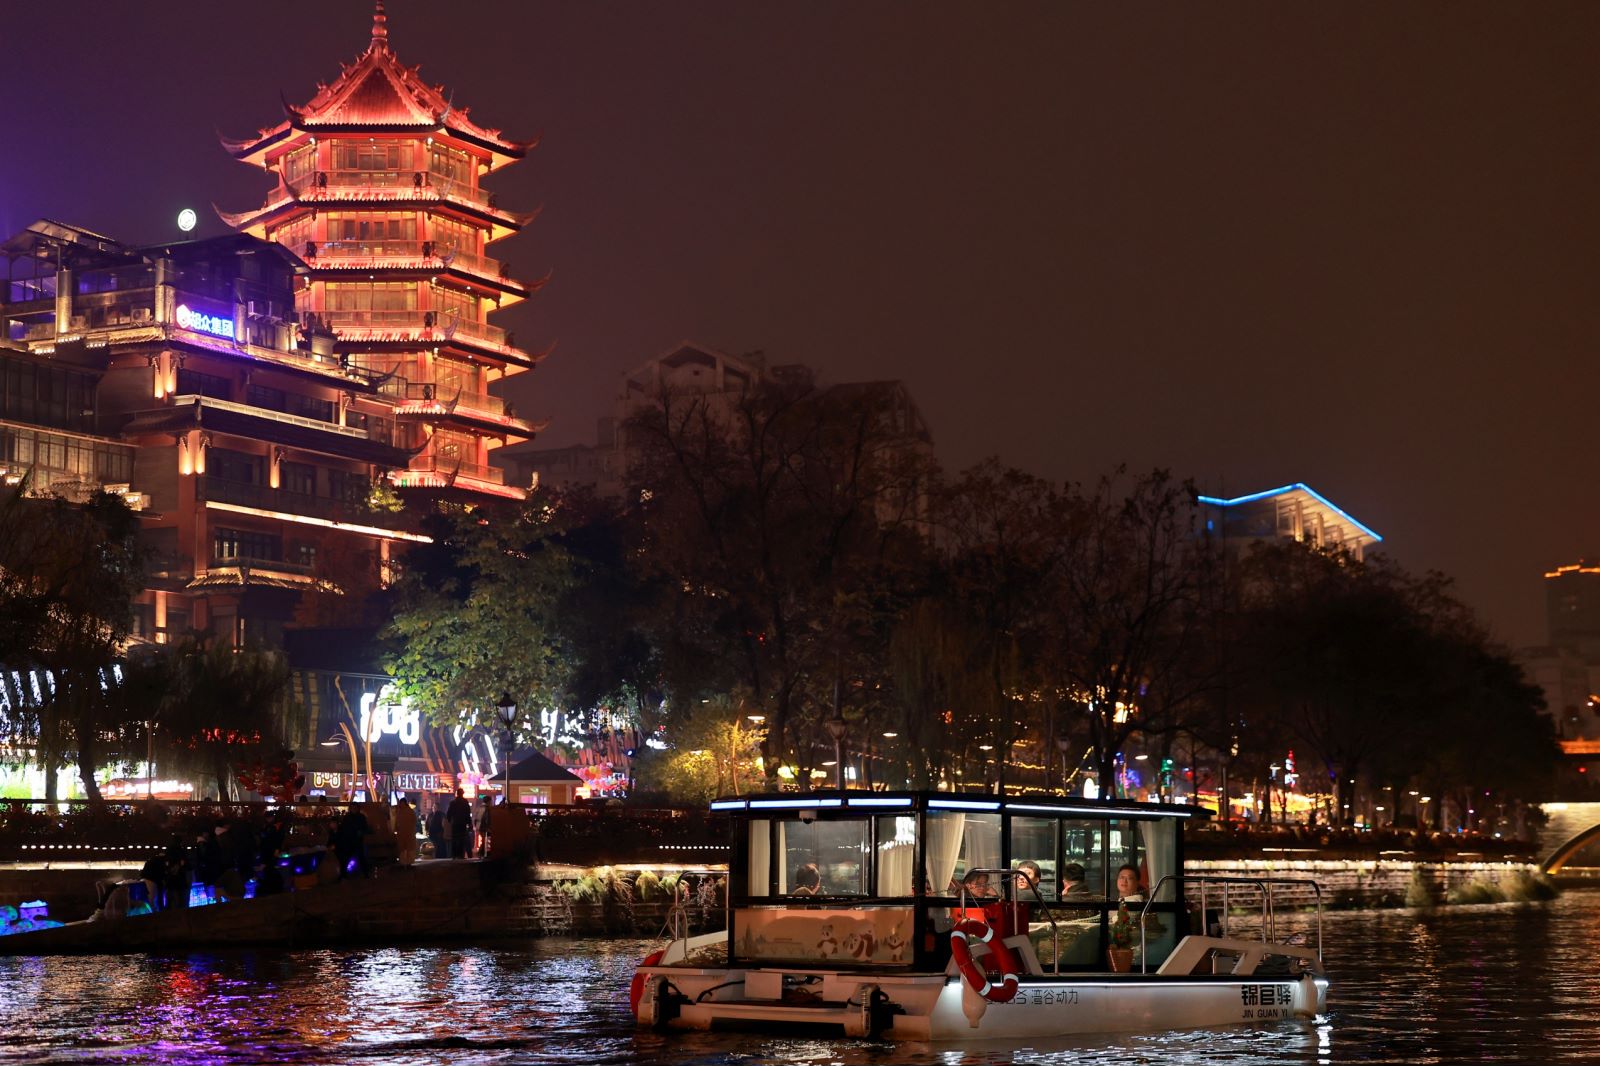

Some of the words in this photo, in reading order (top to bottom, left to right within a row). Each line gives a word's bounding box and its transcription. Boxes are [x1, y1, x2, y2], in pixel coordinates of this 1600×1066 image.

[1241, 984, 1291, 1006] 锦官驿
[1242, 1008, 1254, 1018] JIN
[1257, 1008, 1278, 1018] GUAN
[1281, 1008, 1288, 1017] YI
